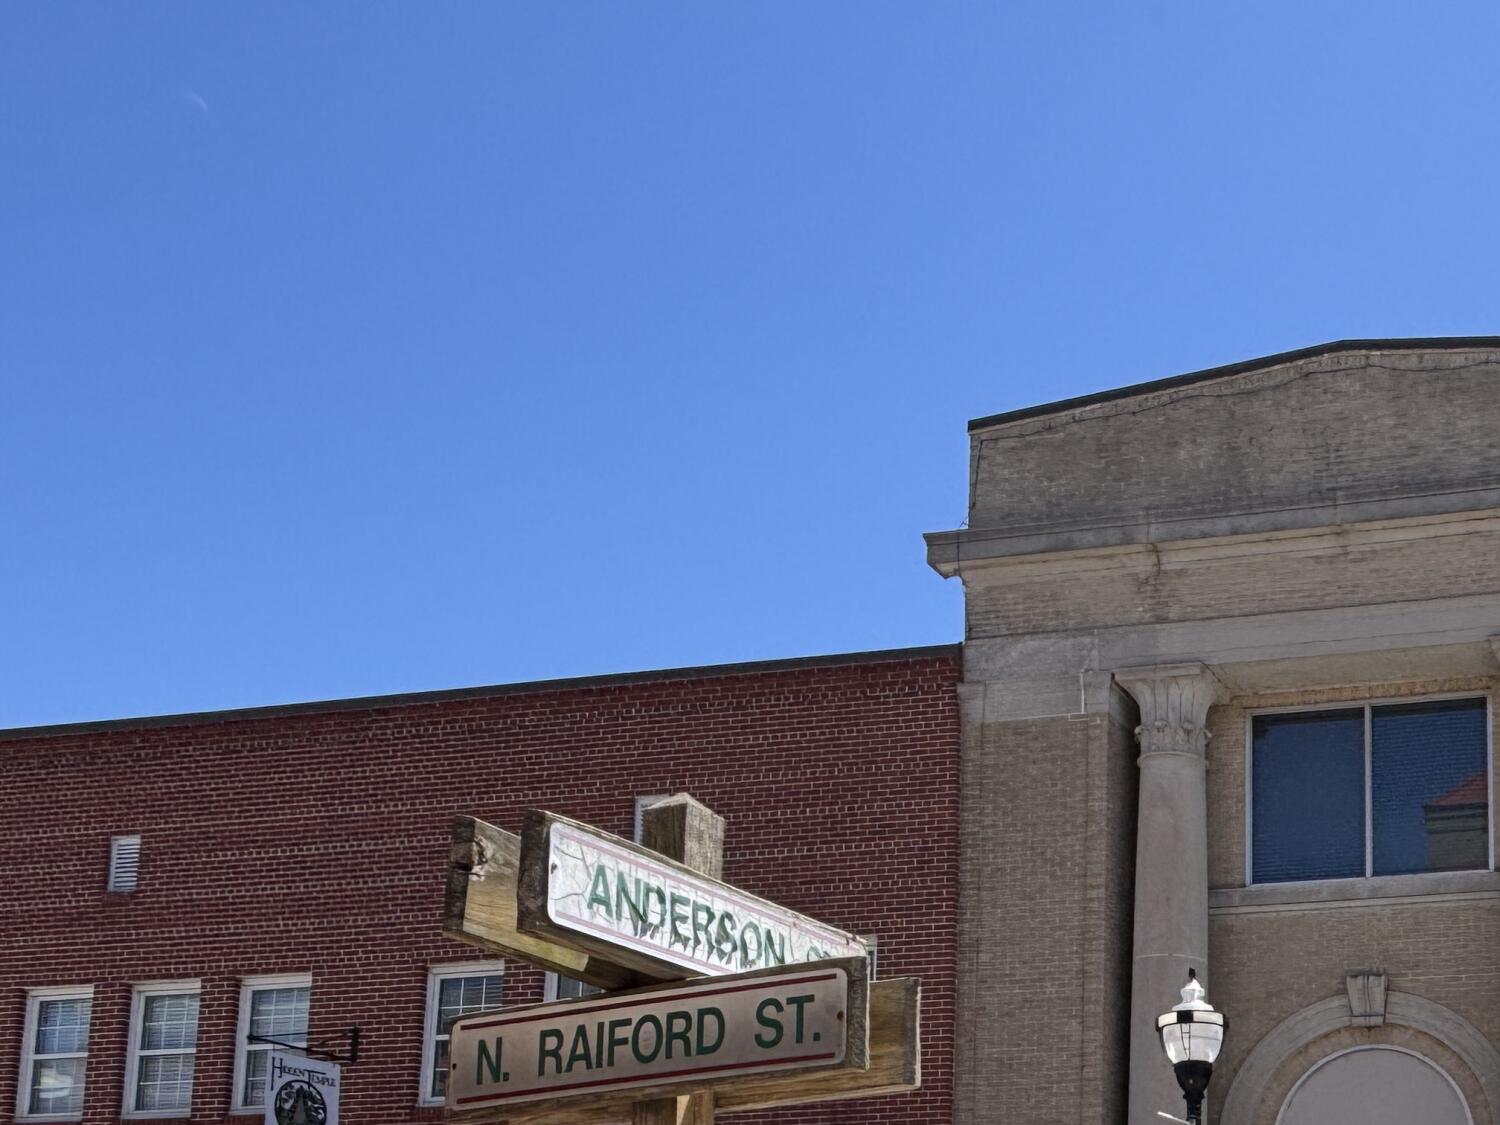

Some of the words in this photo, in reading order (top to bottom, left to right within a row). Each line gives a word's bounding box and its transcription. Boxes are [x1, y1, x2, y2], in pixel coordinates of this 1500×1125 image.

[587, 864, 785, 969] ANDERSON
[475, 1037, 510, 1085] N.
[537, 1006, 726, 1077] RAIFORD
[754, 993, 822, 1049] ST.
